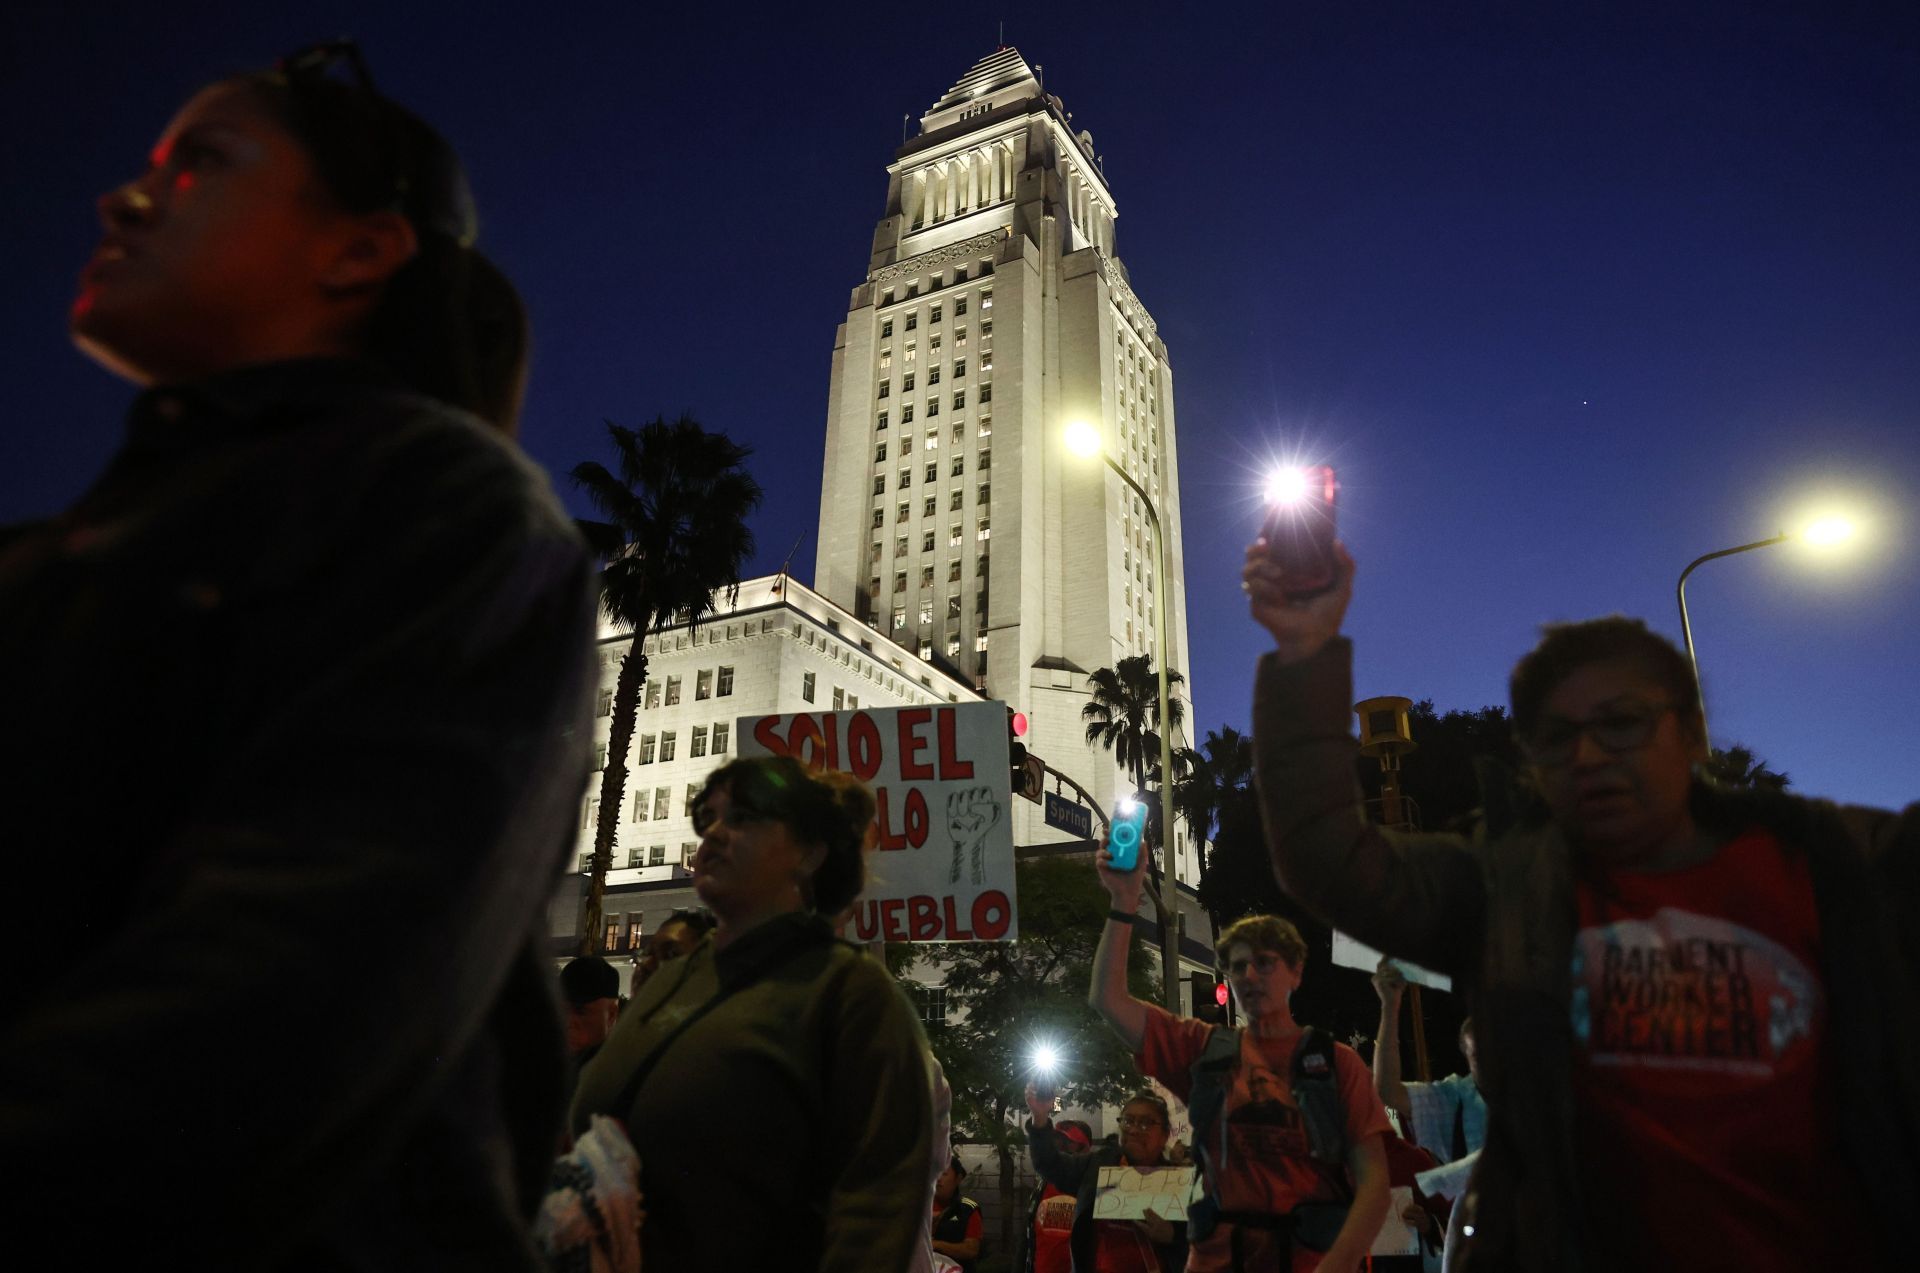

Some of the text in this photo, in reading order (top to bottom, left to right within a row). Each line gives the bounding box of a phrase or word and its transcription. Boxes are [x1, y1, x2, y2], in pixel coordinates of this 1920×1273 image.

[754, 707, 975, 782] SOLO EL
[1050, 800, 1088, 833] Spring
